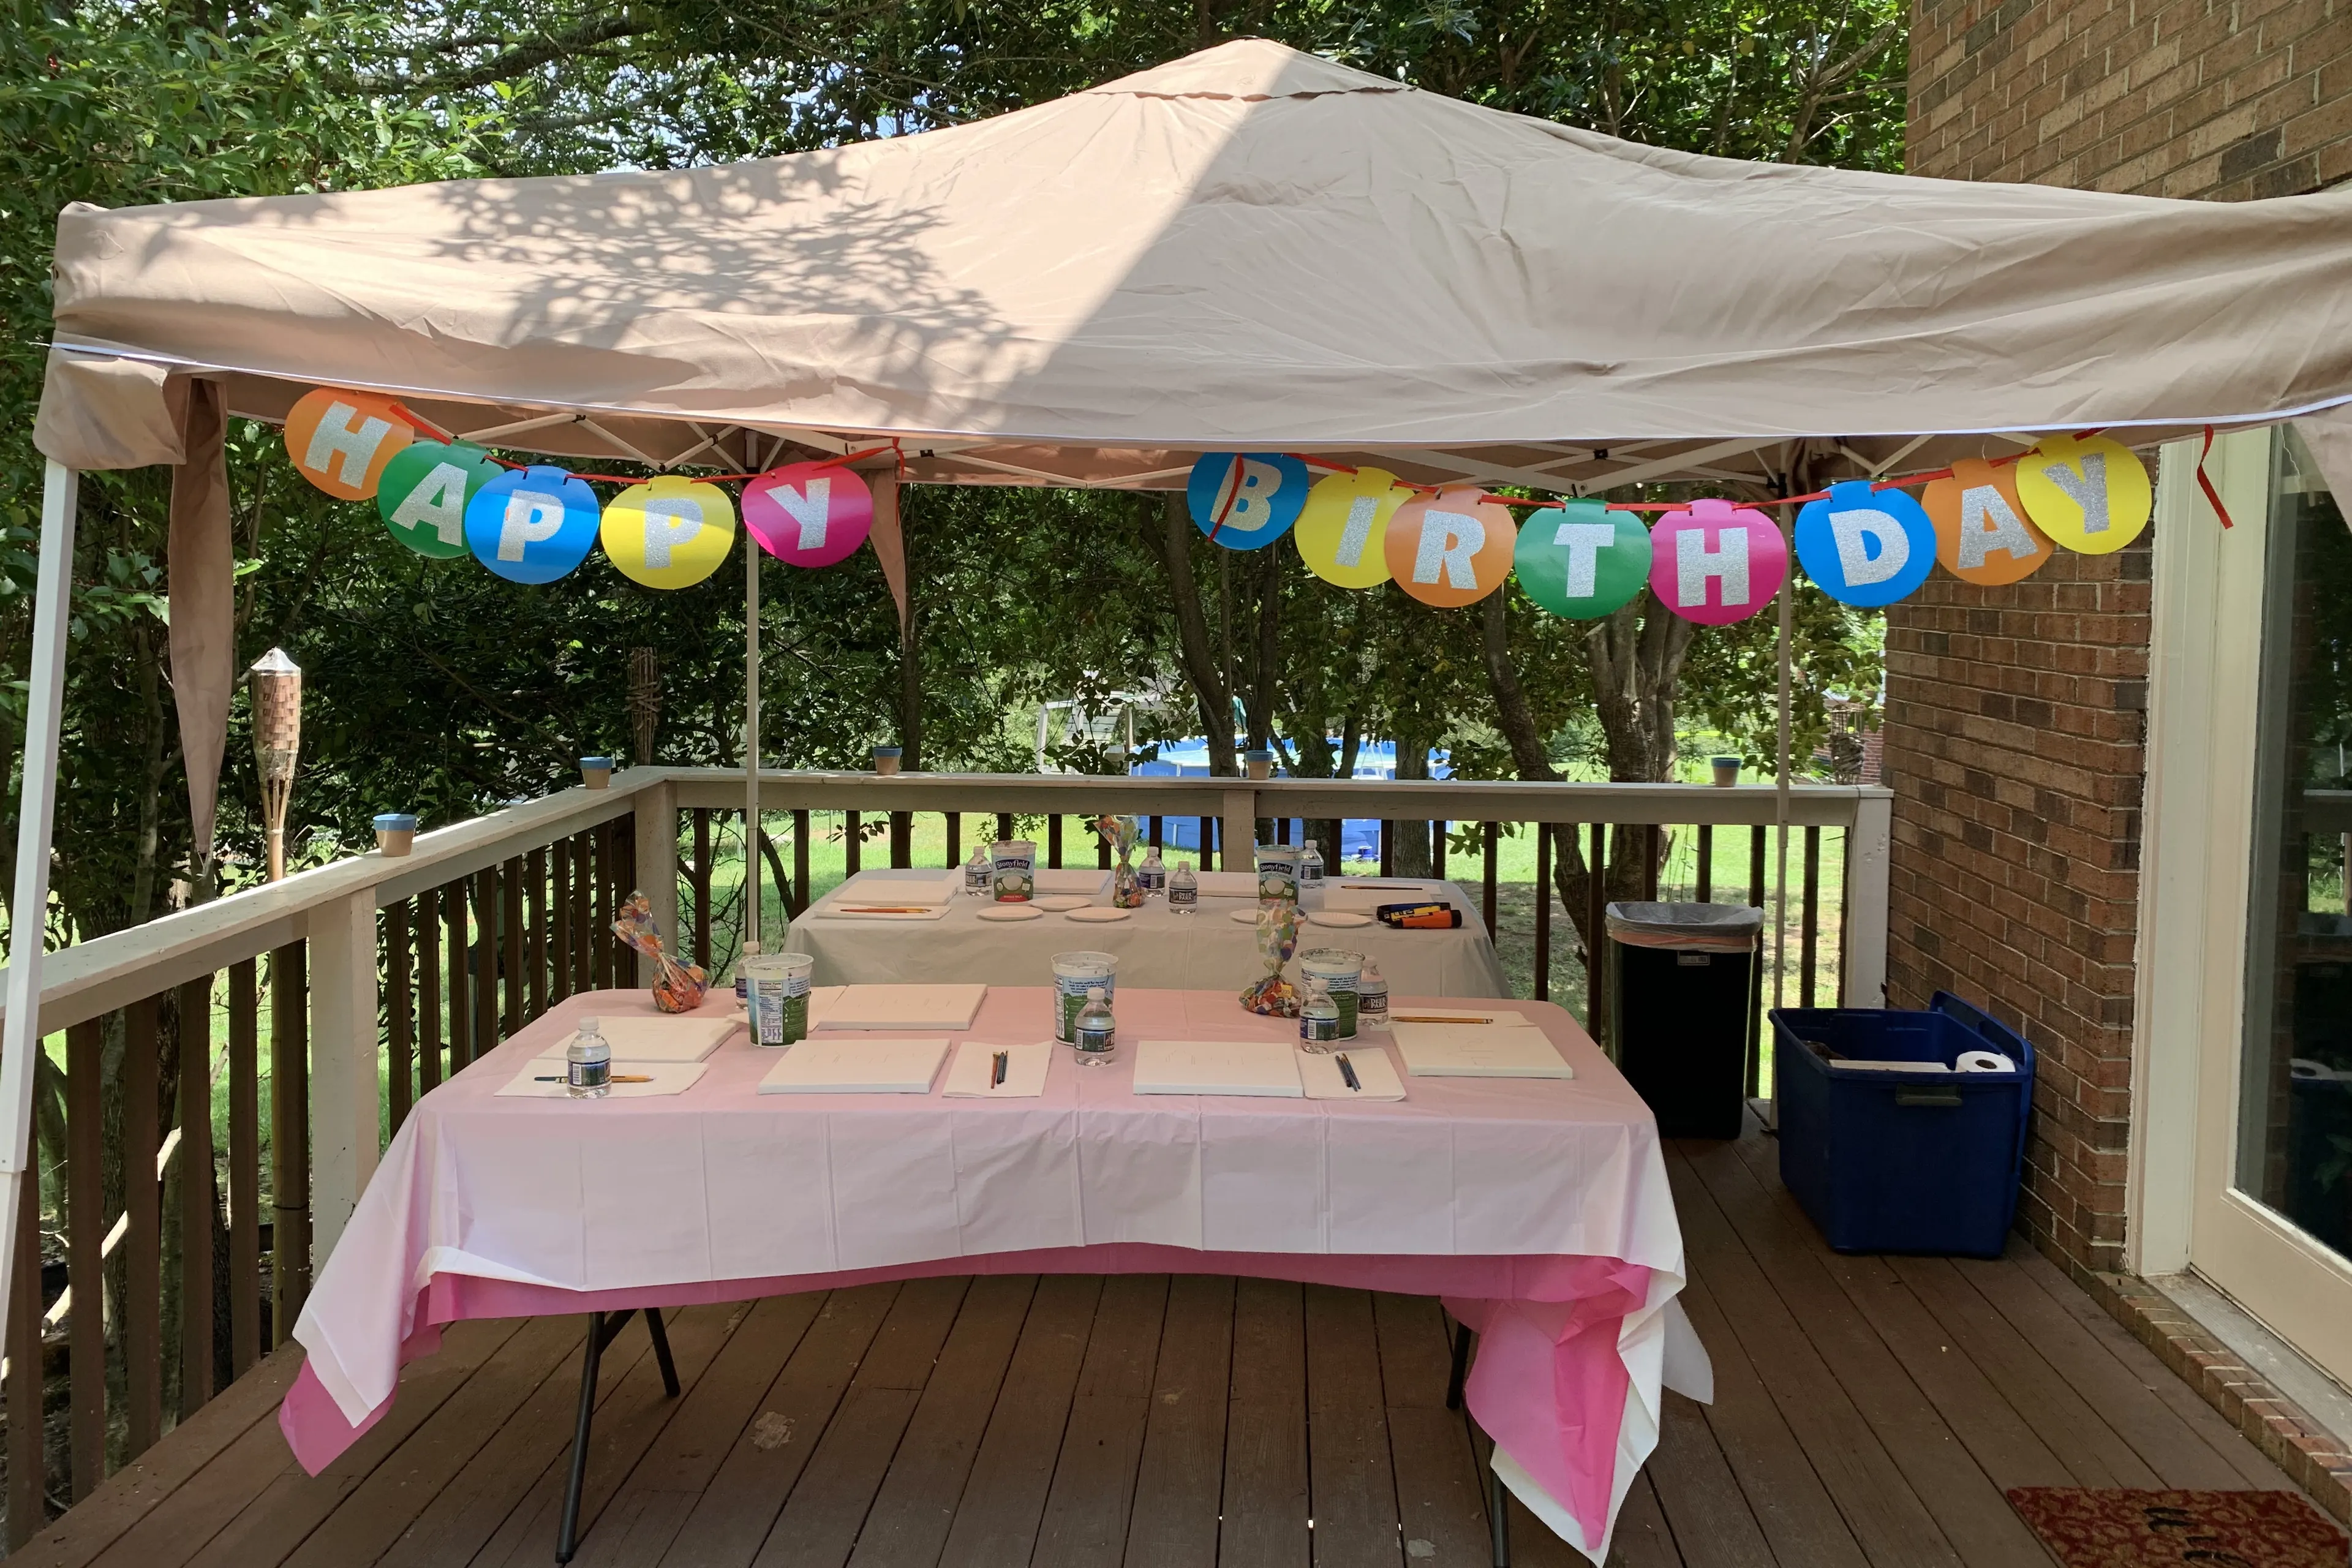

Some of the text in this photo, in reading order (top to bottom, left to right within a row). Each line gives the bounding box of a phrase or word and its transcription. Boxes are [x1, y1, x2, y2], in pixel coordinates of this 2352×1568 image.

[304, 401, 2110, 608] HAPPY BIRTHDAY
[996, 859, 1028, 869] Stonyfield
[1260, 864, 1291, 872] Stonyfield
